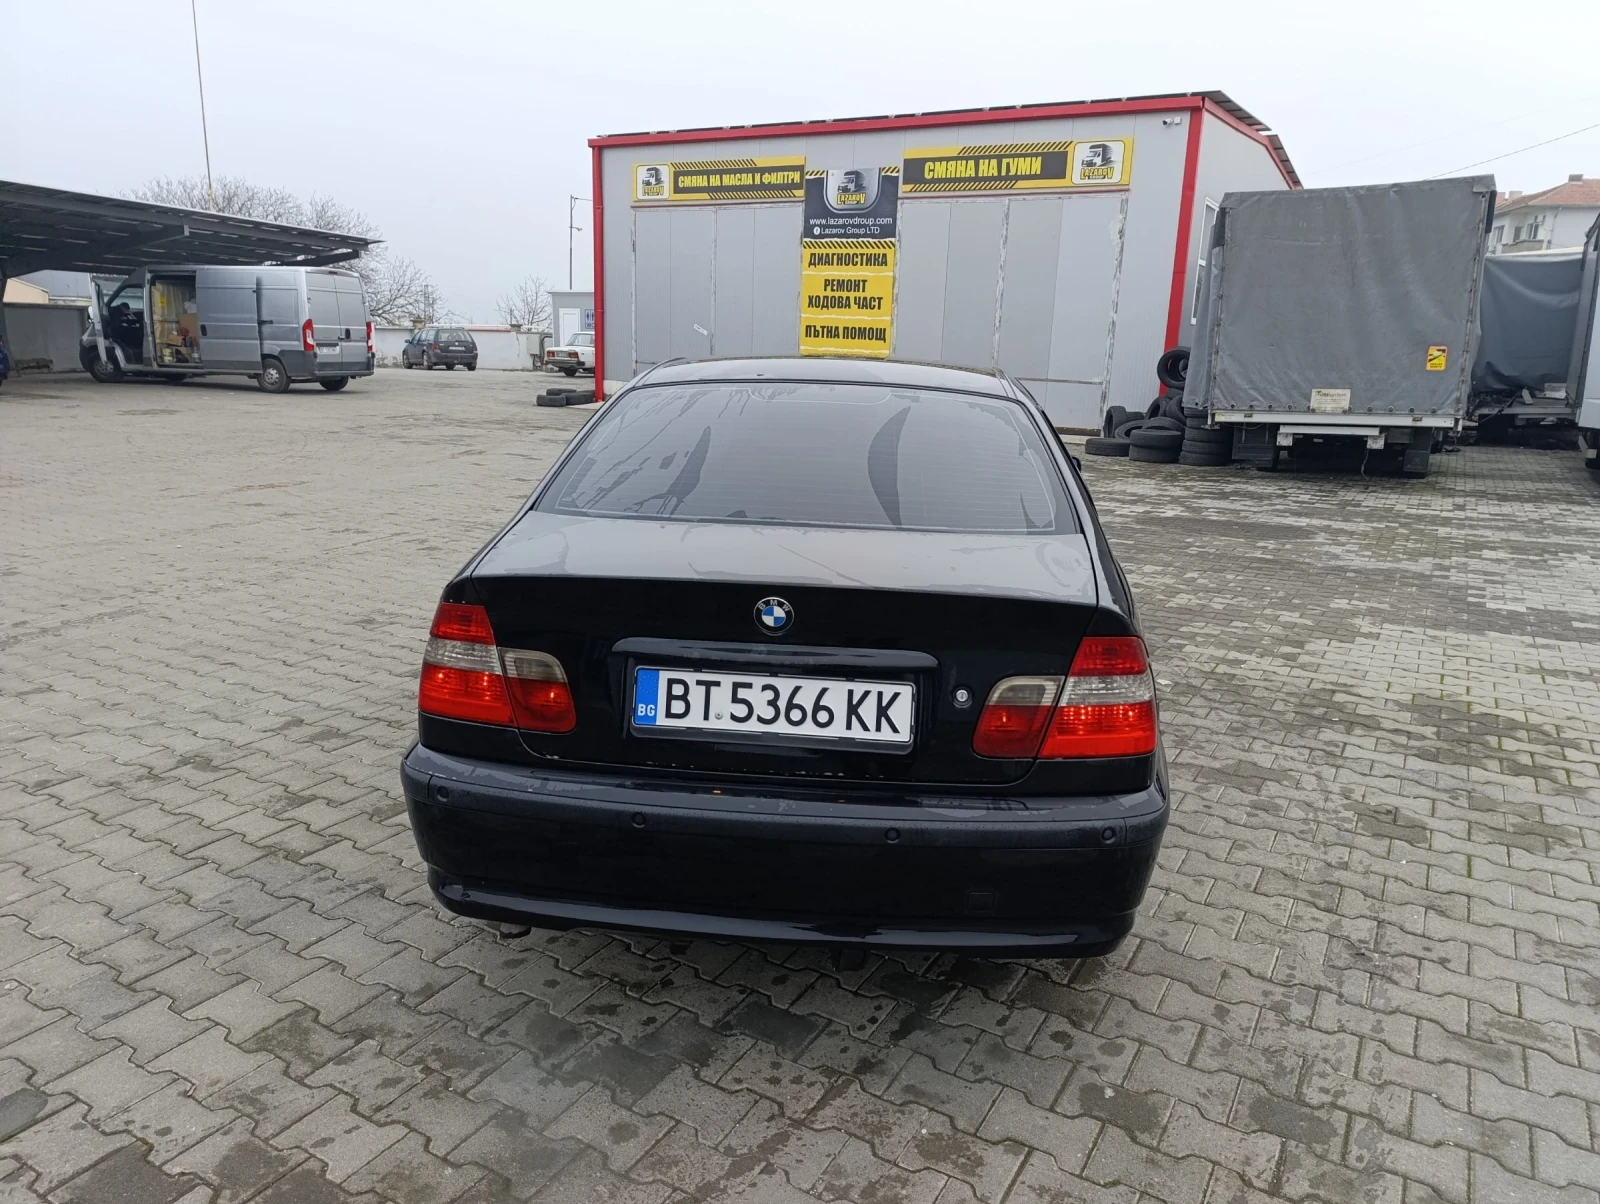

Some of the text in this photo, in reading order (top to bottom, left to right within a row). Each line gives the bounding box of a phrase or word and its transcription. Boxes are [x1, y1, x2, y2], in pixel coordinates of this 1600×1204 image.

[924, 156, 1042, 179] СМЯНА НА ГУМИ
[1080, 167, 1114, 180] LAZAROV
[678, 171, 801, 188] СМЯНА НА МАСЛА И ФИЛТРИ
[836, 192, 866, 205] LAZAROV
[821, 226, 880, 235] Lazarov Group LTD
[808, 252, 888, 268] ДИАГНОСТИКА
[823, 279, 868, 293] РЕМОНТ
[807, 295, 883, 310] ХОДОВА ЧАСТ
[805, 325, 887, 343] ПЪТНА ПОМОЩ
[758, 599, 791, 611] BMW
[637, 704, 655, 717] BG
